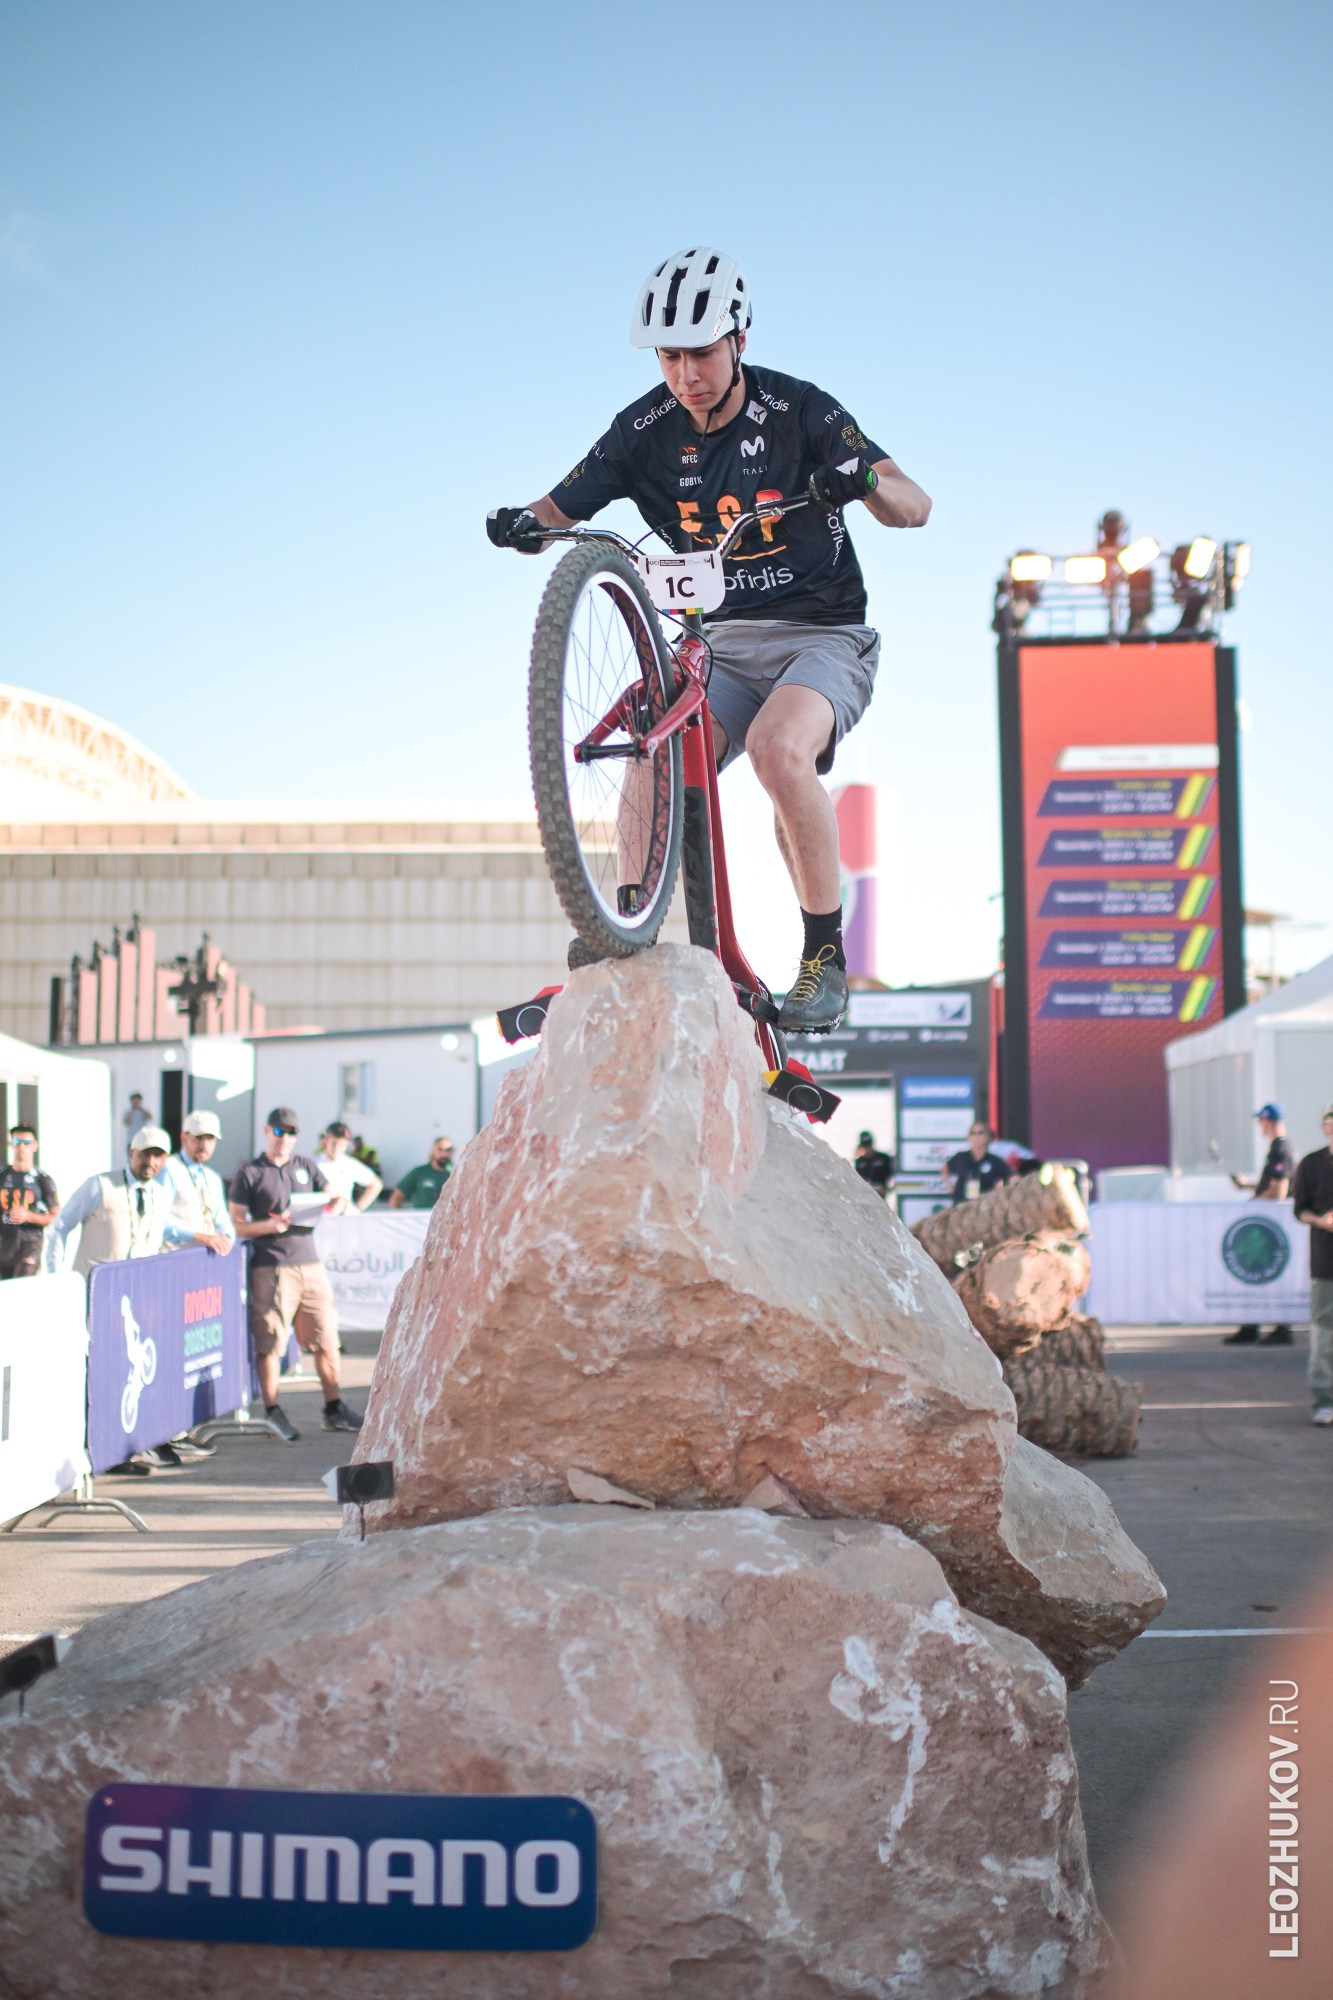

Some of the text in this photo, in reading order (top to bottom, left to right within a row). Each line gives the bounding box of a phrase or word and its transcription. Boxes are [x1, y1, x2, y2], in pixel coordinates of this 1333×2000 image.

[758, 386, 790, 412] ofidis
[633, 397, 677, 430] Cofidis
[681, 454, 698, 464] RFEC
[742, 465, 768, 475] RALI
[679, 476, 703, 487] GOBIK
[677, 488, 784, 551] ESP
[665, 576, 696, 598] 1C
[723, 566, 794, 591] ofidis
[324, 1250, 404, 1278] الرياضة
[184, 1286, 222, 1324] RIYADH
[98, 1823, 581, 1908] SHIMANO
